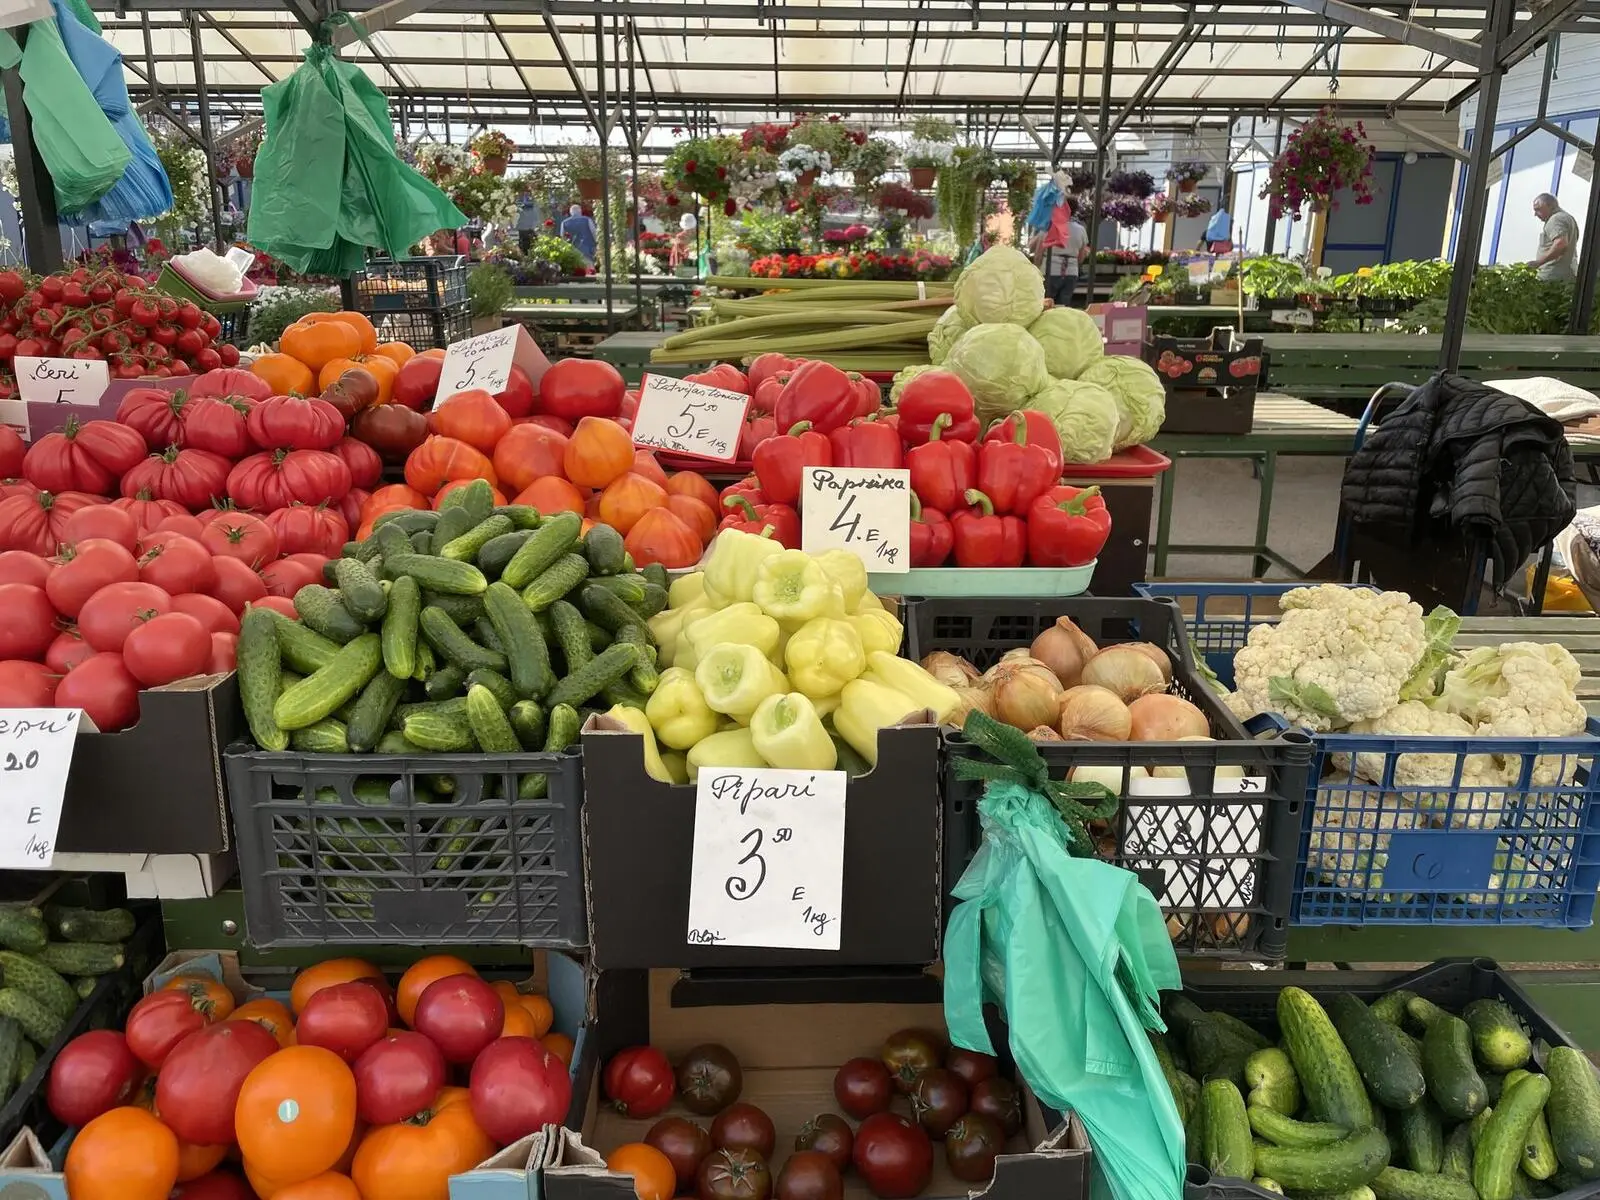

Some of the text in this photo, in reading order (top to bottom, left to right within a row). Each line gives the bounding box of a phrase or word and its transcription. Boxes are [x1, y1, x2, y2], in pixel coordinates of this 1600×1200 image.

[707, 438, 728, 454] 1kg
[812, 469, 906, 500] Paprika
[876, 540, 899, 565] 1kg
[711, 775, 816, 815] Pipari
[27, 806, 42, 824] E
[24, 833, 51, 860] 1kg
[725, 827, 806, 901] 3 50 E
